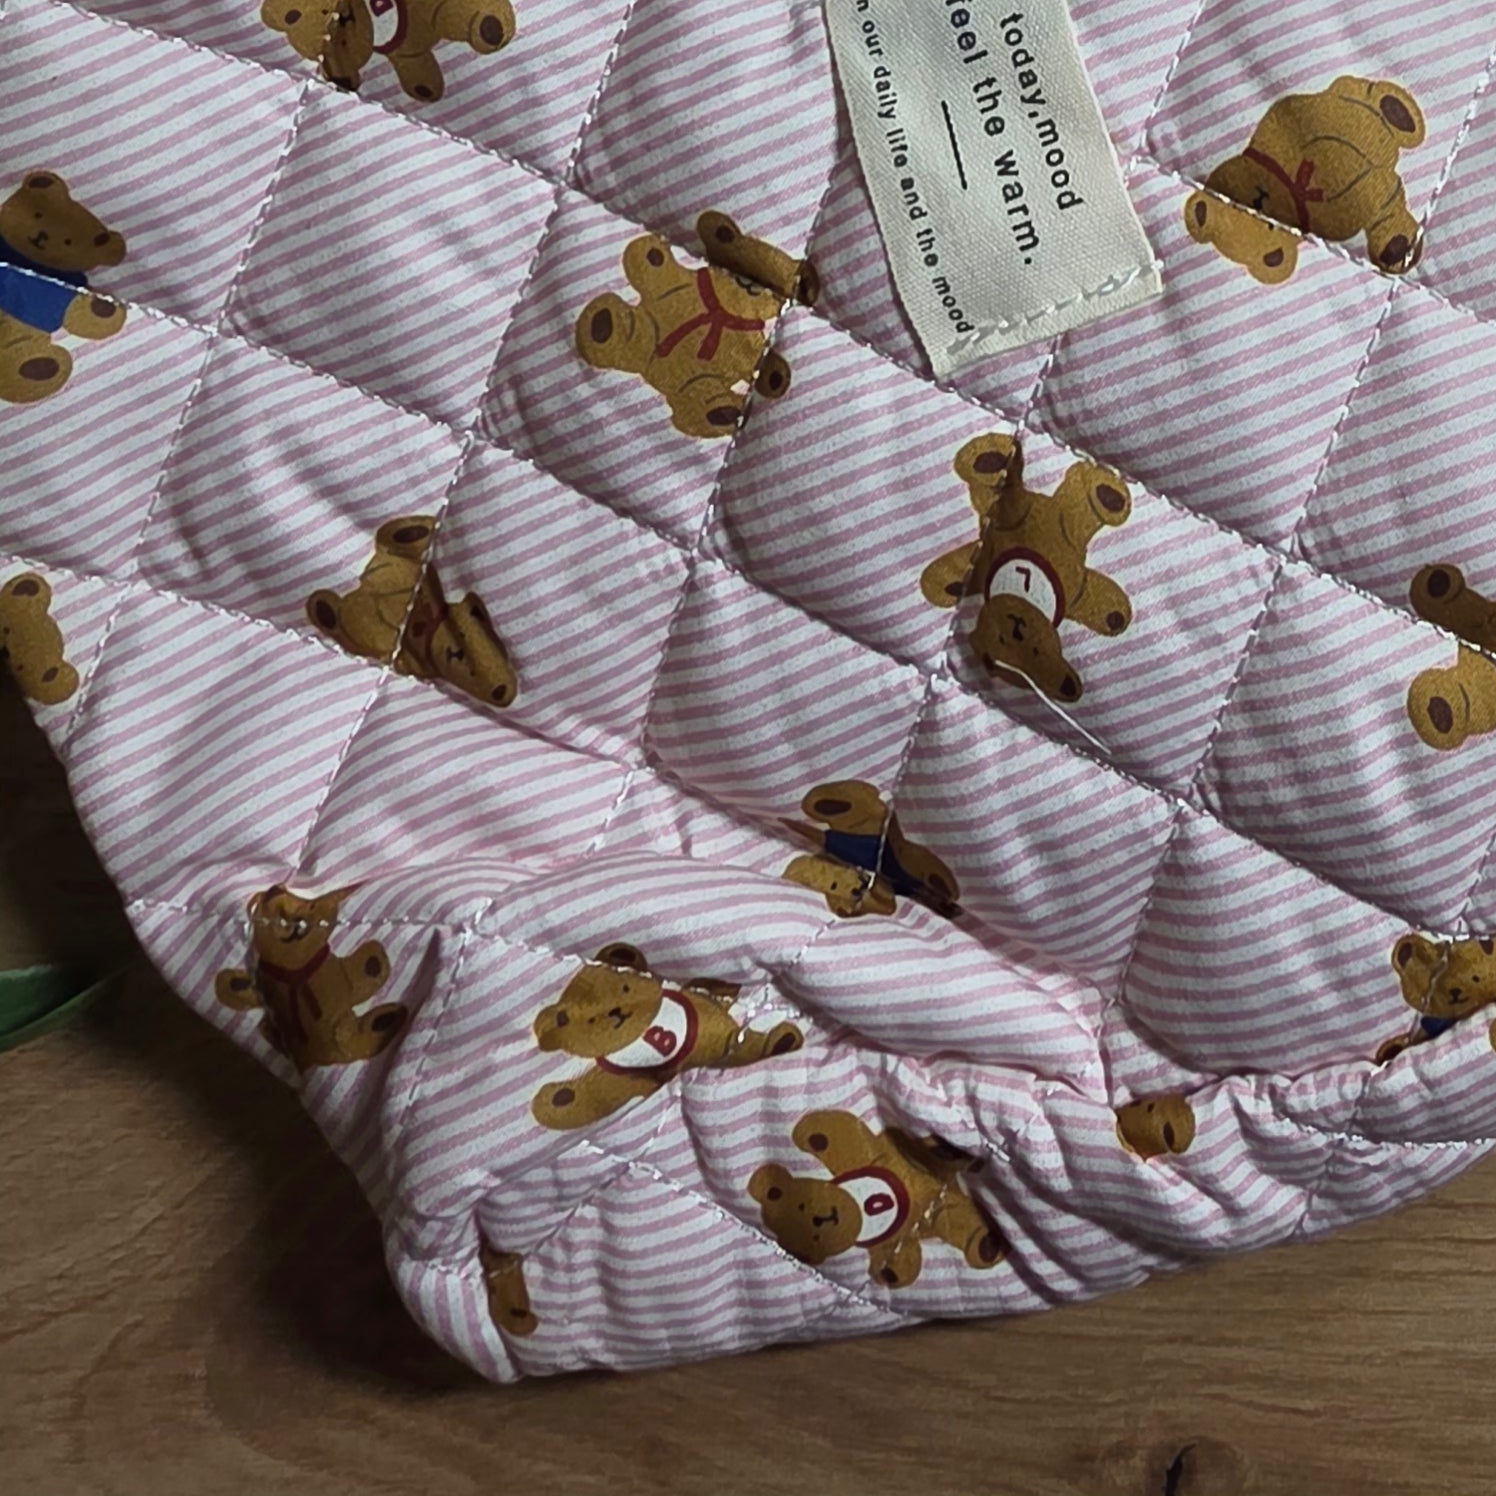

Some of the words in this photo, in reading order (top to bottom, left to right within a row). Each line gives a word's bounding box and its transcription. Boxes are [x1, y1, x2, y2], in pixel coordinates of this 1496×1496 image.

[862, 20, 883, 56] our
[874, 66, 898, 119] daily
[886, 128, 908, 168] life
[901, 177, 928, 221] and
[916, 228, 939, 267] the
[932, 276, 975, 333] mood
[973, 76, 1005, 136] the
[994, 149, 1040, 265] warm.
[1000, 12, 1084, 210] today,mood
